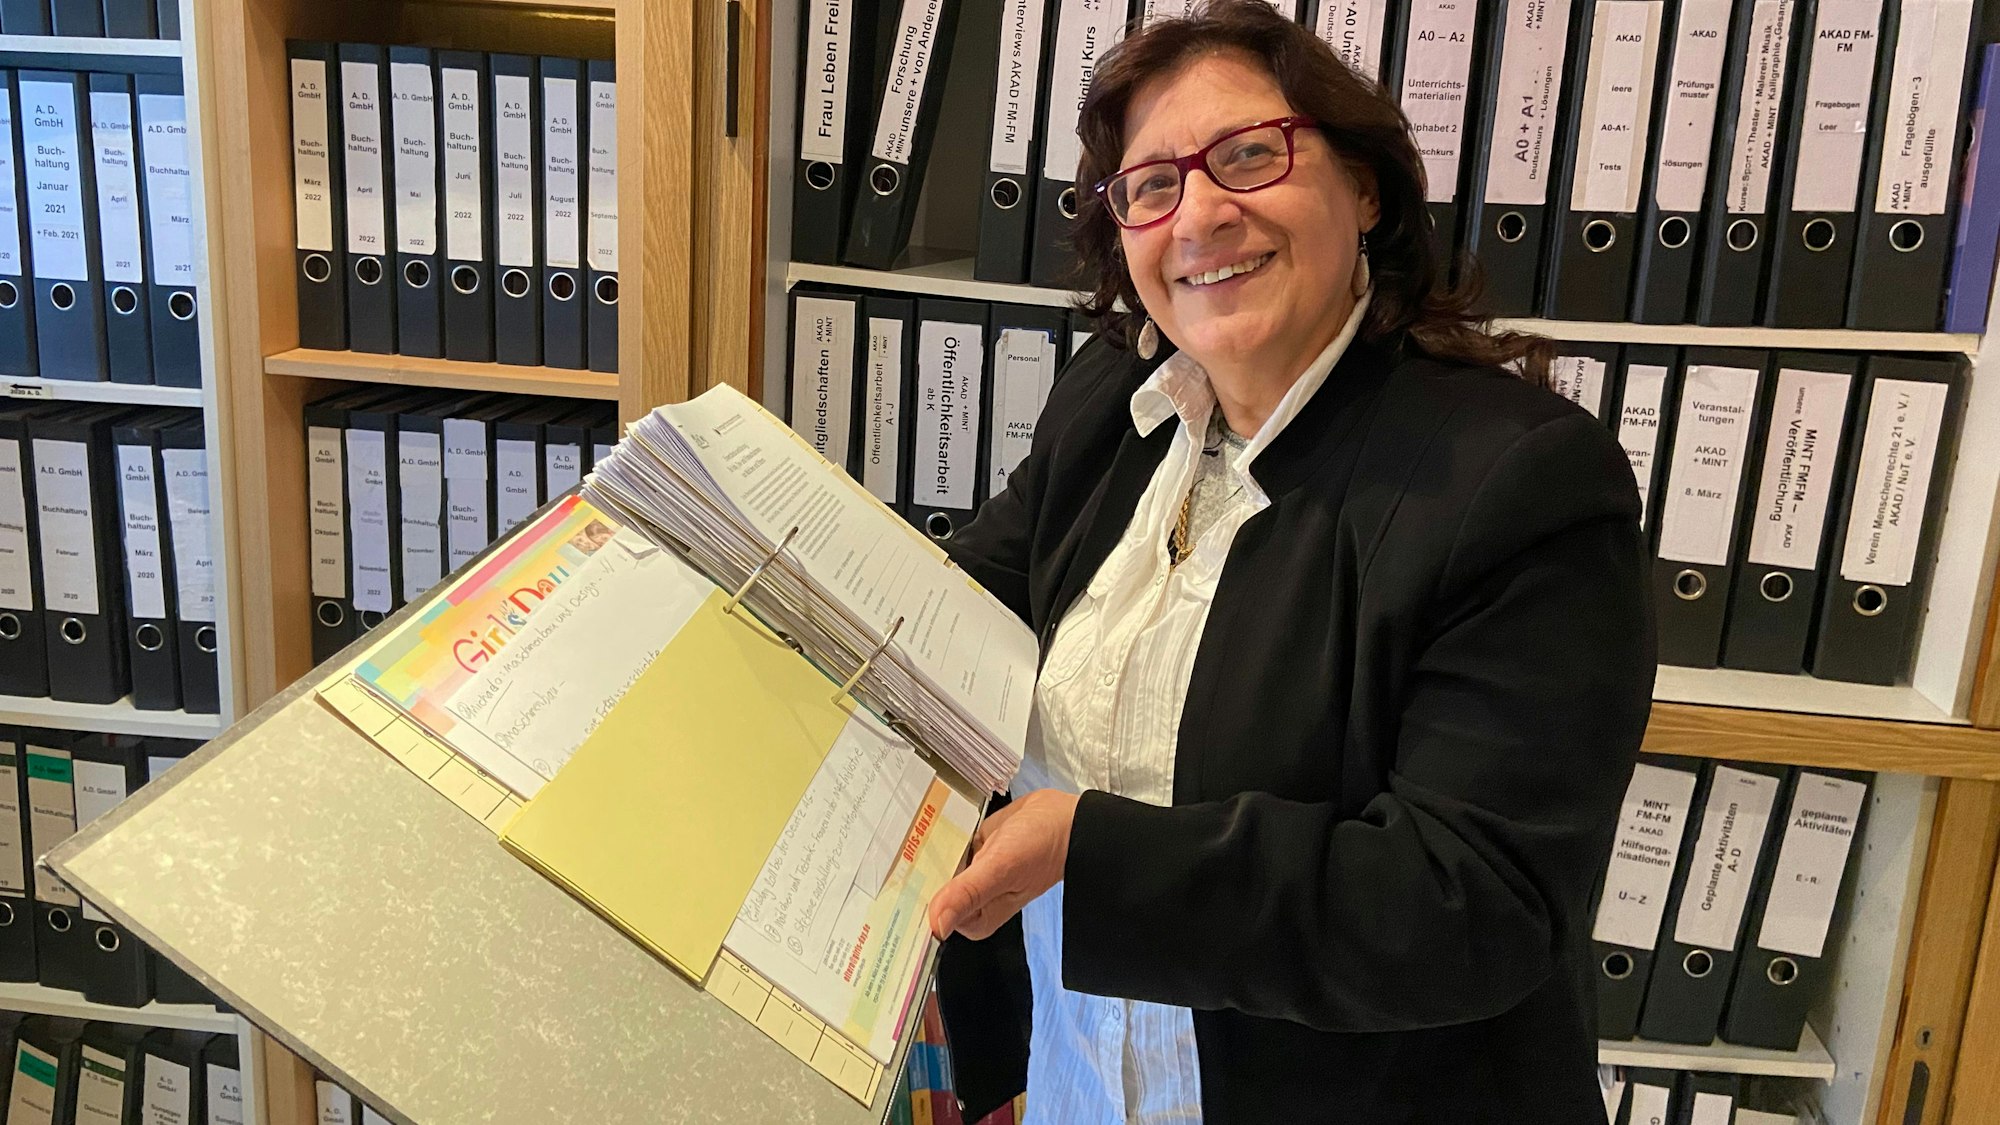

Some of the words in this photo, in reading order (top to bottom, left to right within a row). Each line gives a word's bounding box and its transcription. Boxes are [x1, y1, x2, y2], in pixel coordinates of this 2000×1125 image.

[825, 0, 839, 36] Frei
[1345, 8, 1357, 26] A0
[1526, 2, 1535, 28] AKAD
[918, 0, 938, 49] Andere
[1012, 0, 1028, 57] nterviews
[1418, 31, 1434, 41] A0
[1449, 32, 1465, 42] A2
[1689, 30, 1718, 38] -AKAD
[1819, 30, 1851, 39] AKAD
[1853, 31, 1874, 40] FM-
[1082, 26, 1096, 61] Kurs
[1342, 31, 1355, 61] Unte
[1836, 43, 1853, 52] FM
[892, 26, 917, 94] Forschung
[914, 52, 926, 75] von
[822, 42, 837, 94] Leben
[1768, 41, 1781, 100] Kalligraphie
[1009, 60, 1022, 98] AKAD
[1408, 79, 1464, 89] Unterrichts-
[1678, 80, 1715, 90] Prüfungs
[1748, 108, 1761, 144] Theater
[1762, 25, 1773, 54] Musik
[298, 91, 321, 99] GmbH
[1409, 92, 1461, 101] materialien
[1680, 91, 1710, 99] muster
[350, 102, 374, 110] GmbH
[448, 102, 474, 111] GmbH
[1815, 100, 1860, 109] Fragebogen
[503, 111, 526, 119] GmbH
[901, 91, 916, 132] unsere
[34, 117, 63, 128] GmbH
[819, 100, 832, 138] Frau
[1005, 102, 1018, 143] FM-FM
[1529, 125, 1543, 180] Deutschkurs
[1541, 65, 1553, 113] Lösungen
[1767, 107, 1777, 130] MINT
[550, 126, 572, 134] GmbH
[1411, 123, 1449, 133] lphabet
[1451, 124, 1457, 132] 2
[1515, 139, 1529, 162] A0
[1522, 95, 1534, 117] A1
[1819, 123, 1837, 131] Leer
[1901, 94, 1920, 156] Fragebögen
[351, 134, 374, 143] Buch-
[450, 132, 474, 141] Buch-
[404, 138, 426, 147] Buch-
[447, 142, 477, 152] haltung
[885, 133, 896, 157] AKAD
[37, 146, 65, 156] Buch-
[104, 148, 125, 157] Buch-
[298, 149, 325, 157] haltung
[348, 144, 377, 154] haltung
[400, 147, 429, 157] haltung
[1761, 143, 1770, 168] AKAD
[1920, 128, 1936, 188] ausgefüllte
[35, 159, 70, 171] haltung
[102, 157, 128, 167] haltung
[501, 162, 528, 171] haltung
[1599, 163, 1621, 171] Tests
[1662, 160, 1703, 168] -lösungen
[549, 165, 574, 175] haltung
[455, 172, 471, 180] Juni
[36, 181, 68, 191] Januar
[304, 178, 321, 186] März
[357, 186, 372, 194] April
[1903, 180, 1912, 203] MINT
[111, 194, 127, 203] April
[550, 195, 575, 203] August
[1891, 183, 1901, 209] AKAD
[45, 204, 66, 214] 2021
[171, 215, 189, 224] März
[43, 229, 59, 238] Feb.
[61, 230, 79, 240] 2021
[825, 316, 833, 337] MINT
[1008, 354, 1040, 363] Personal
[960, 376, 968, 399] AKAD
[926, 387, 935, 400] ab
[815, 349, 829, 454] itgliedschaften
[1625, 407, 1655, 416] AKAD
[1693, 402, 1745, 414] Veranstal-
[871, 363, 883, 465] Öffentlichkeitsarbeit
[937, 337, 960, 495] Öffentlichkeitsarbeit
[1623, 418, 1657, 427] FM-FM
[1699, 414, 1735, 425] tungen
[1008, 422, 1032, 430] AKAD
[1006, 431, 1033, 440] FM-FM
[1805, 429, 1817, 461] MINT
[1695, 446, 1726, 456] AKAD
[418, 459, 439, 467] GmbH
[553, 463, 575, 471] GmbH
[1702, 458, 1728, 467] MINT
[58, 468, 83, 476] GmbH
[1770, 420, 1801, 522] Veröffentlichung
[126, 474, 150, 482] GmbH
[1793, 464, 1811, 501] FMFM
[506, 486, 527, 494] GmbH
[1685, 488, 1694, 496] 8.
[1697, 489, 1722, 499] März
[1889, 495, 1904, 526] AKAD
[1898, 464, 1911, 485] NuT
[453, 505, 475, 513] Buch-
[1865, 531, 1880, 565] Verein
[1873, 443, 1900, 529] Menschenrechte
[42, 505, 88, 516] Buchhaltung
[315, 508, 339, 516] haltung
[130, 513, 153, 522] Buch-
[450, 514, 477, 523] haltung
[127, 523, 156, 531] haltung
[403, 517, 439, 529] Buchhaltung
[315, 529, 339, 537] Oktober
[1784, 524, 1793, 548] AKAD
[137, 571, 155, 579] 2020
[1643, 799, 1670, 812] MINT
[1636, 810, 1671, 824] FM-FM
[1801, 808, 1848, 824] geplante
[902, 803, 936, 863] girls-day.de
[1639, 826, 1664, 836] AKAD
[1794, 820, 1852, 837] Aktivitäten
[1621, 839, 1672, 856] Hilfsorga-
[1616, 850, 1671, 868] nisationen
[1701, 859, 1723, 911] Geplante
[1720, 802, 1739, 862] Aktivitäten
[1618, 891, 1628, 900] U
[1638, 895, 1647, 904] Z
[843, 923, 871, 983] eltern@girls-day.de
